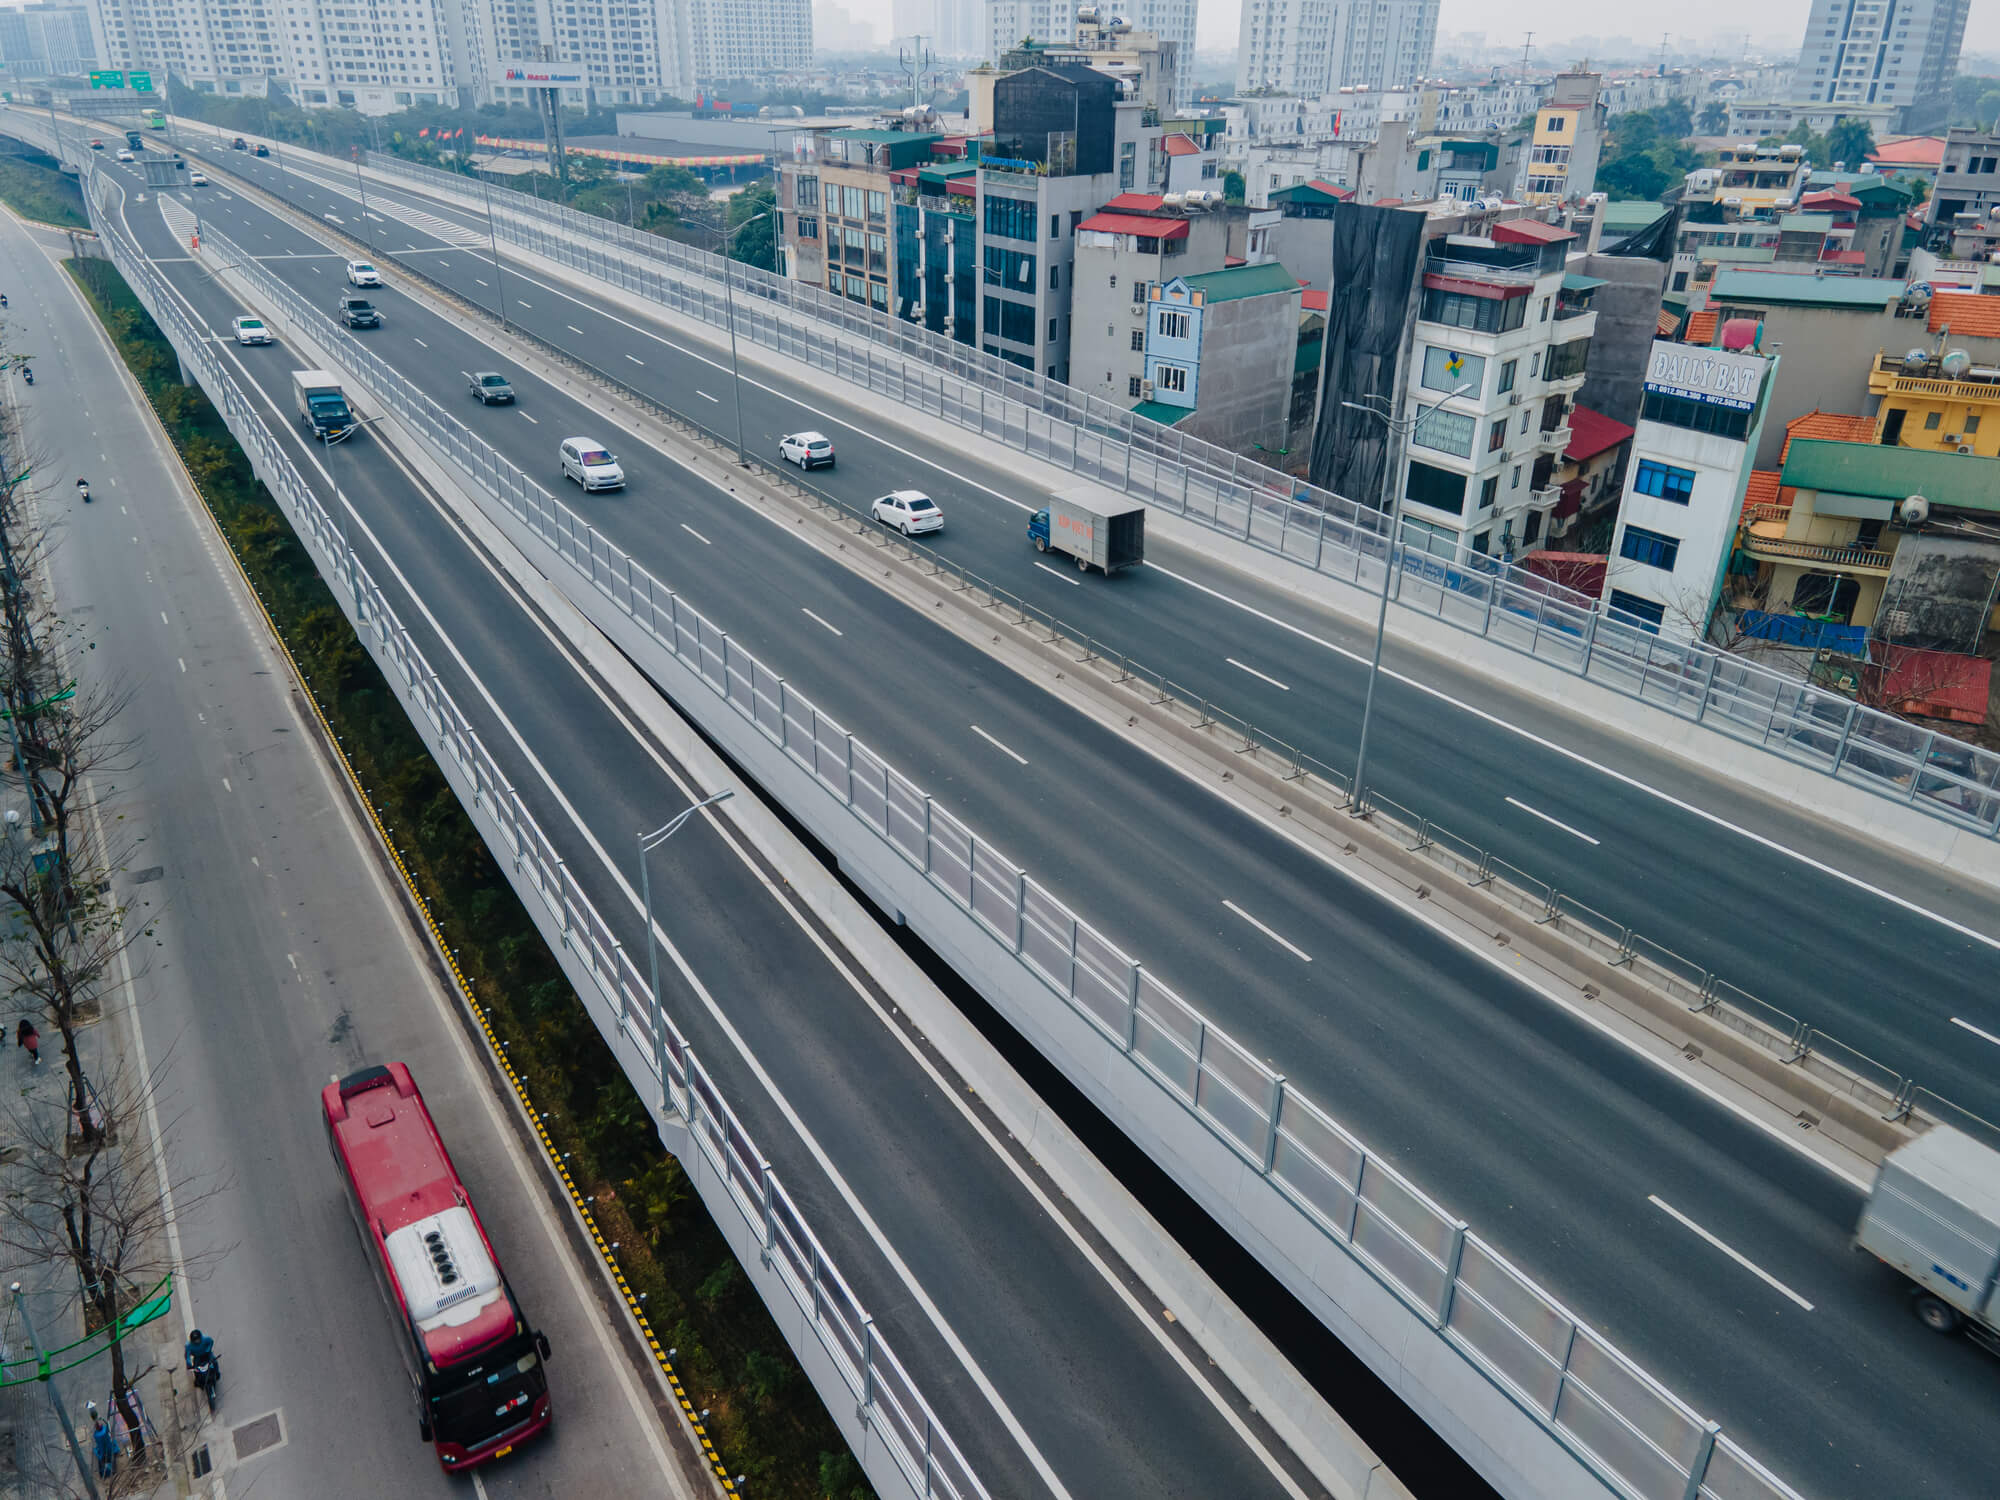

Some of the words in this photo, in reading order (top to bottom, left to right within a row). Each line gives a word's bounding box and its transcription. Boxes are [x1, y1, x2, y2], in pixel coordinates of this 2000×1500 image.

[1653, 352, 1689, 385] ĐẠI
[1688, 356, 1715, 388] LÝ
[1713, 363, 1755, 397] BẠT
